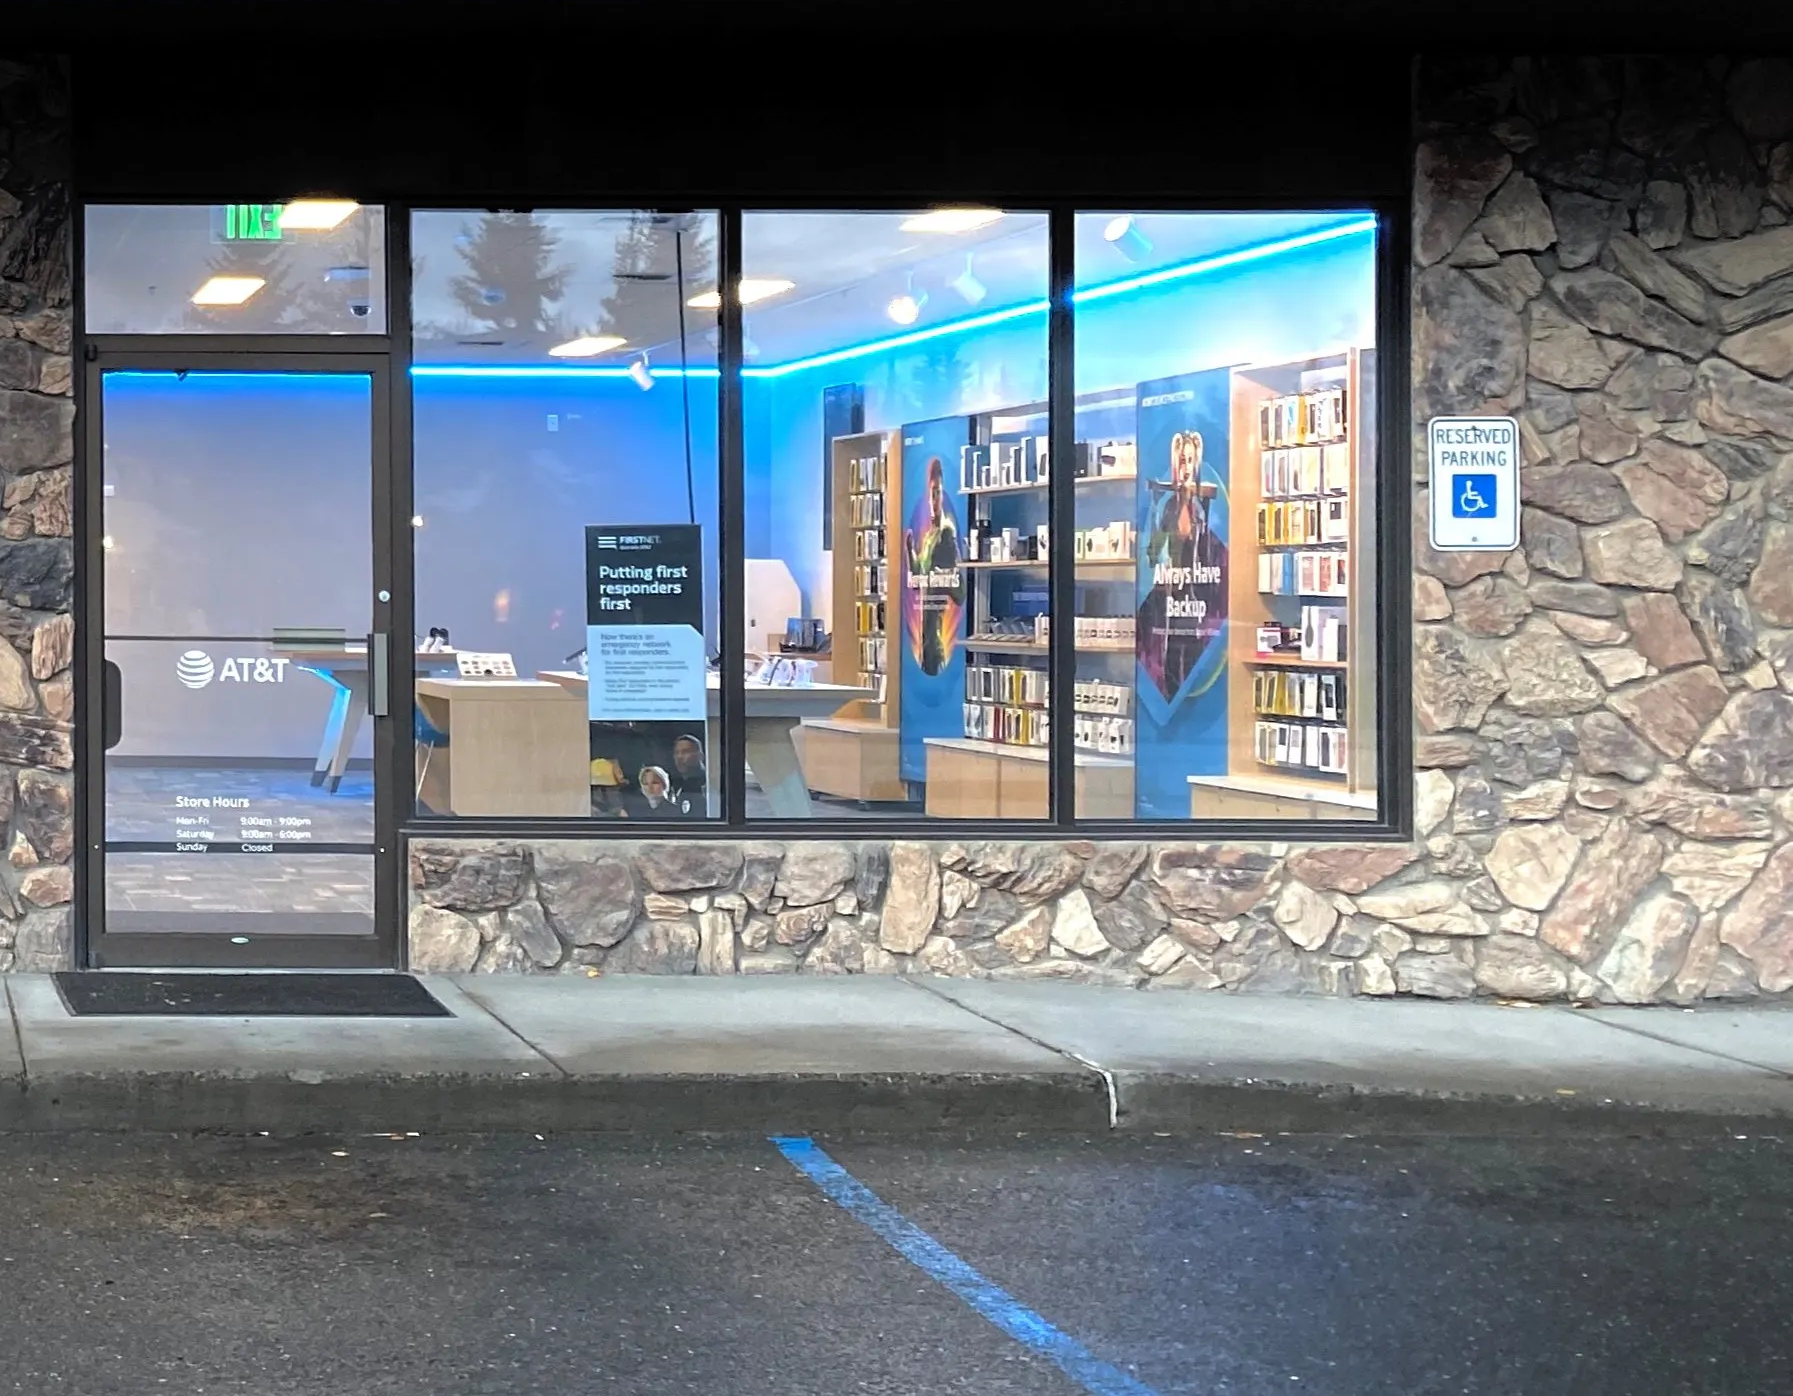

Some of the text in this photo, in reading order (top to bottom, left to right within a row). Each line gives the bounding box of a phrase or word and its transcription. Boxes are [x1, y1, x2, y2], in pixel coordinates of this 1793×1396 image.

[1436, 429, 1511, 444] RESERVED
[1441, 451, 1507, 466] PARKING
[599, 565, 688, 581] Putting first
[1153, 562, 1221, 590] Always Have
[599, 581, 682, 596] responders
[599, 597, 632, 610] first
[1166, 594, 1206, 623] Backup
[219, 657, 290, 683] AT&T
[175, 795, 250, 808] Store Hours
[176, 829, 215, 840] Saturday
[176, 842, 274, 853] Sunday Closed
